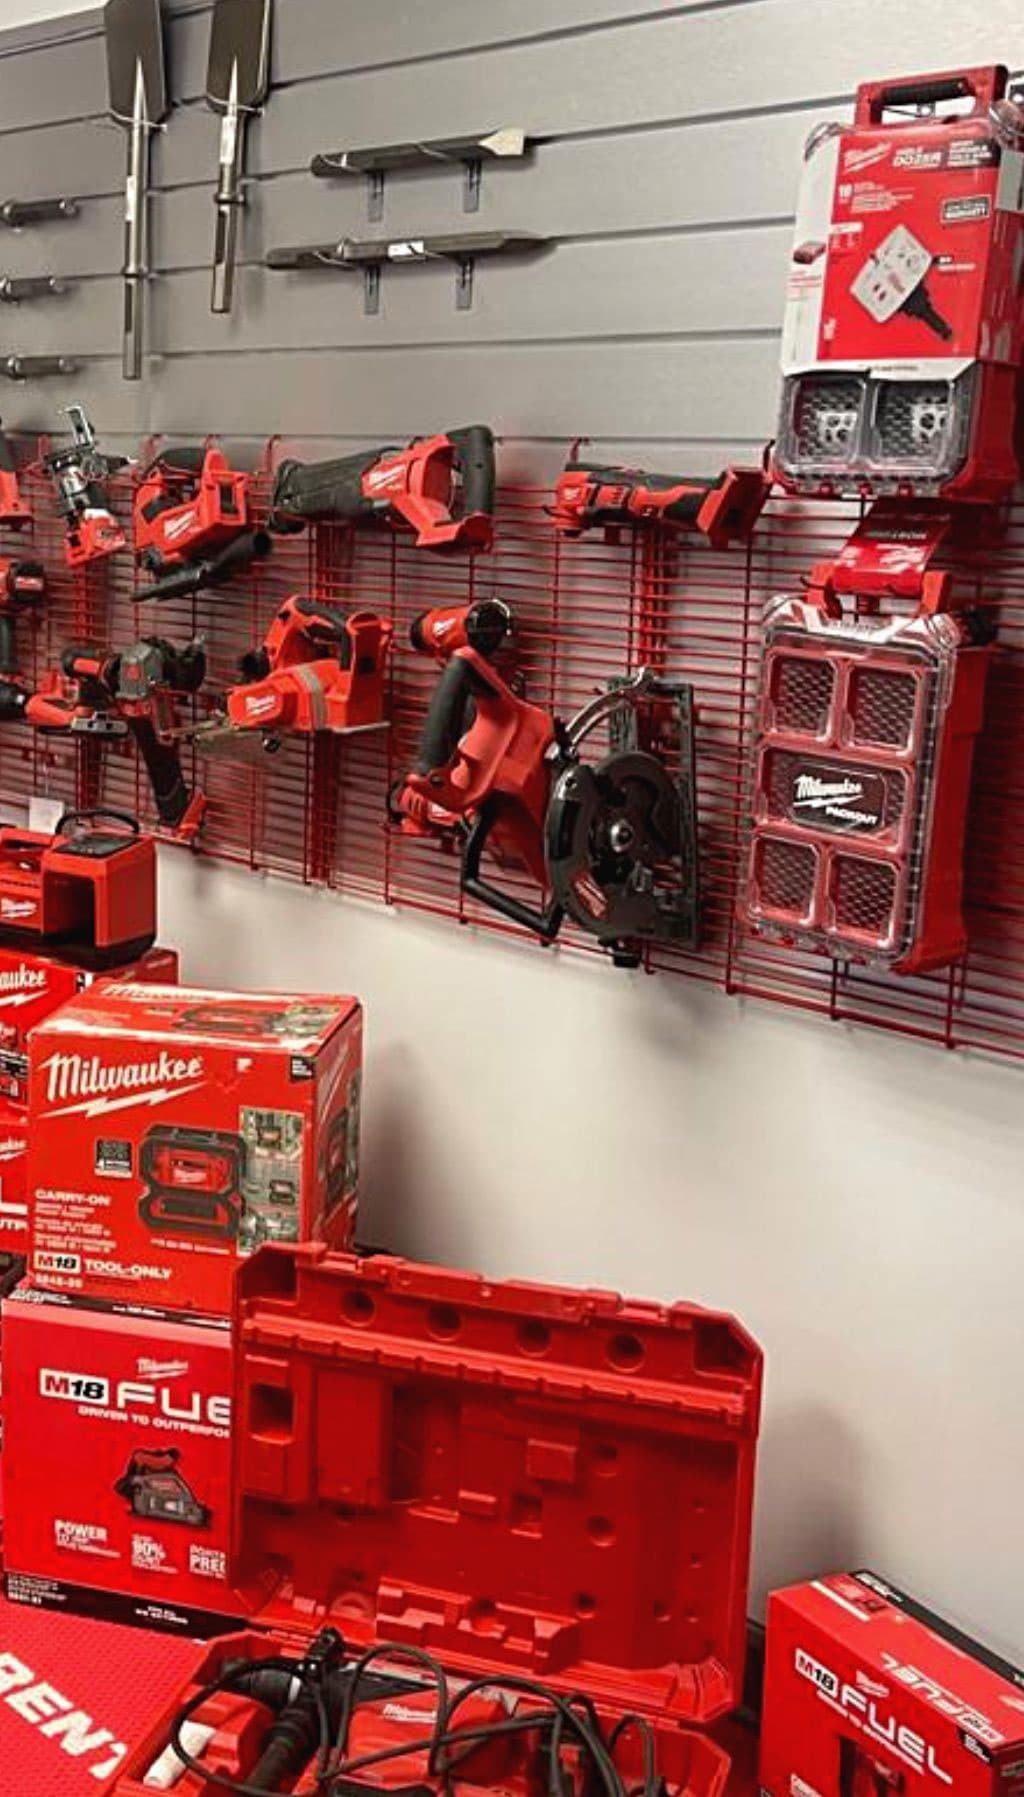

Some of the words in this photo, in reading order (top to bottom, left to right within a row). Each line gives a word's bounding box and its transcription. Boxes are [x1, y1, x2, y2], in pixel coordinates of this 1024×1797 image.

[38, 1051, 204, 1101] Milwaukee
[34, 1189, 111, 1206] CARRY-ON
[36, 1254, 78, 1271] M18
[85, 1258, 172, 1280] TOOL-ONLY
[44, 1373, 106, 1400] M18
[78, 1405, 128, 1422] DRIVEN
[131, 1413, 150, 1426] TO
[55, 1520, 107, 1541] POWER
[797, 1653, 836, 1693] M18
[842, 1685, 953, 1785] FUEL
